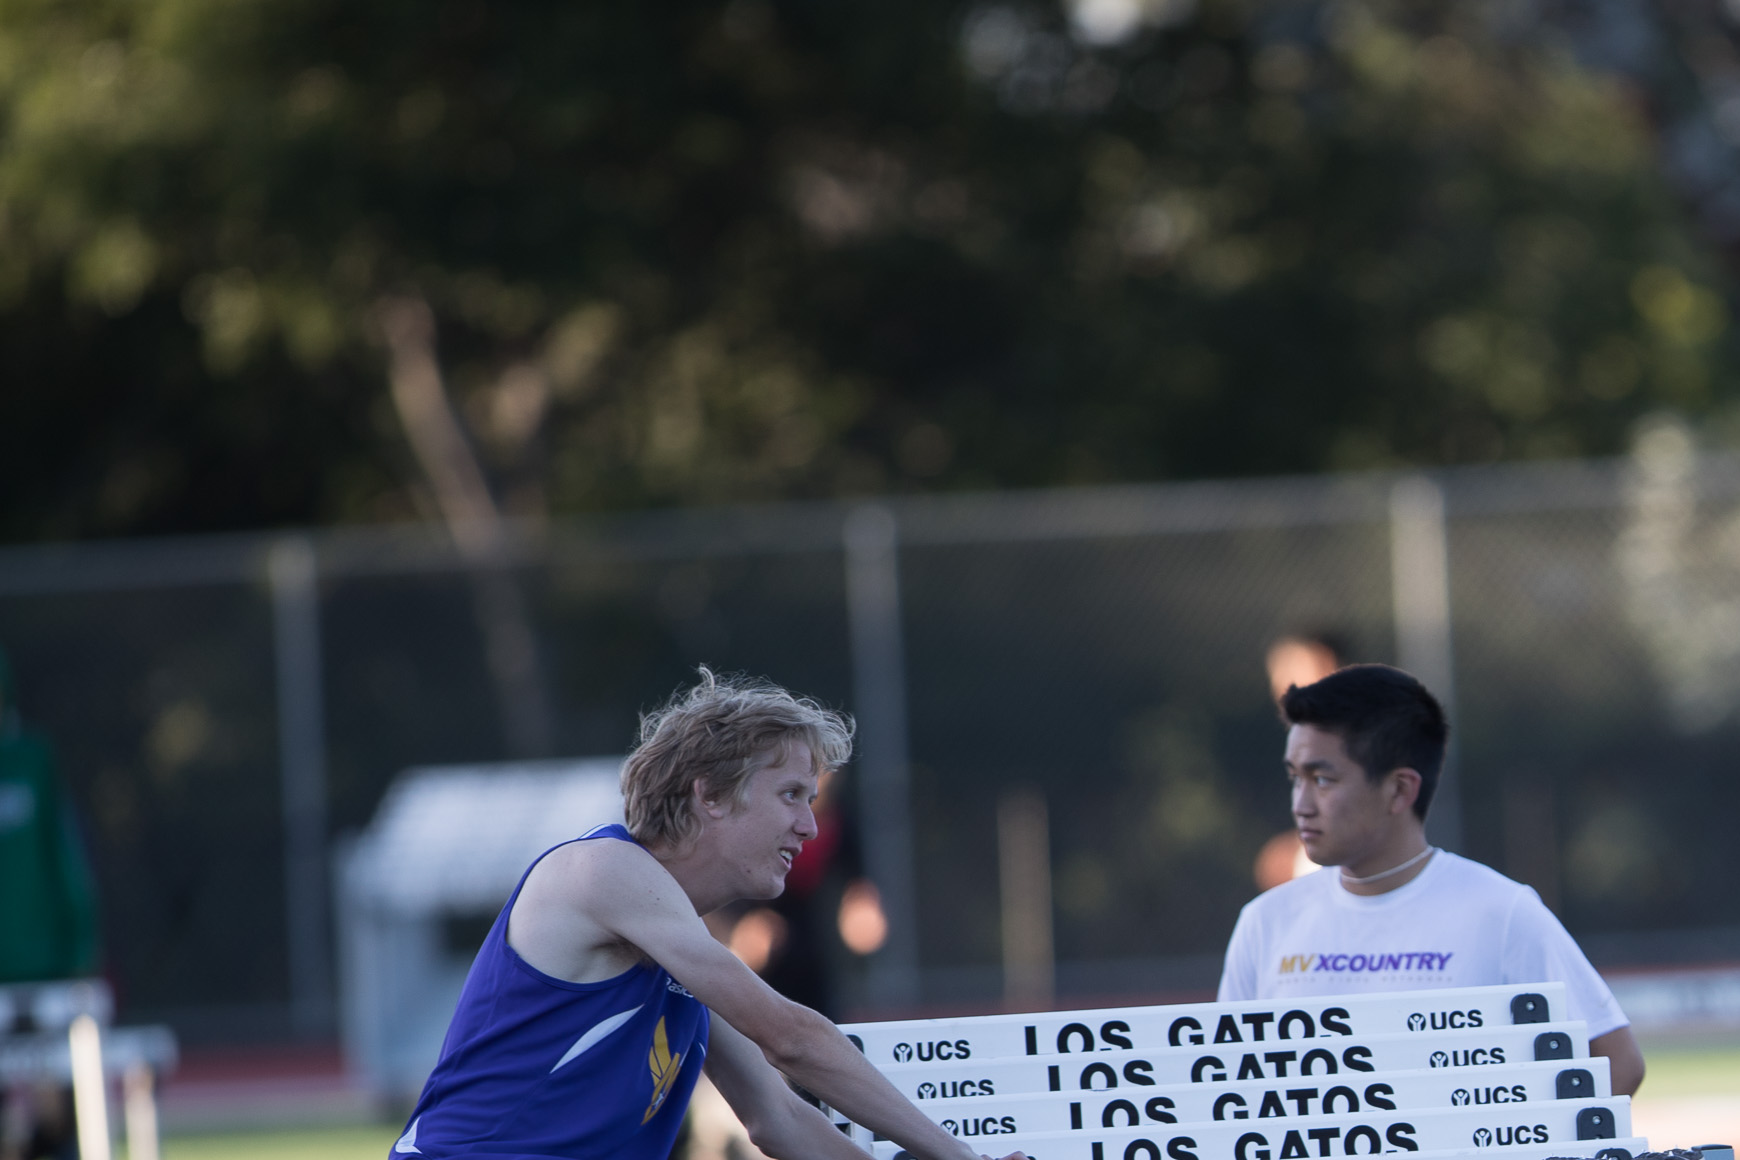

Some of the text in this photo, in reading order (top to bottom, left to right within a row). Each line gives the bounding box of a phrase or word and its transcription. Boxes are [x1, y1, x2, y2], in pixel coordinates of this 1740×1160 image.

[917, 1040, 970, 1061] UCS
[1168, 1007, 1353, 1046] GATOS
[1430, 1010, 1483, 1030] UCS
[941, 1080, 994, 1098] UCS
[1191, 1046, 1375, 1083] GATOS
[1453, 1048, 1505, 1066] UCS
[963, 1117, 1016, 1136] UCS
[1212, 1083, 1397, 1121] GATOS
[1474, 1085, 1527, 1104] UCS
[1496, 1125, 1549, 1145] UCS
